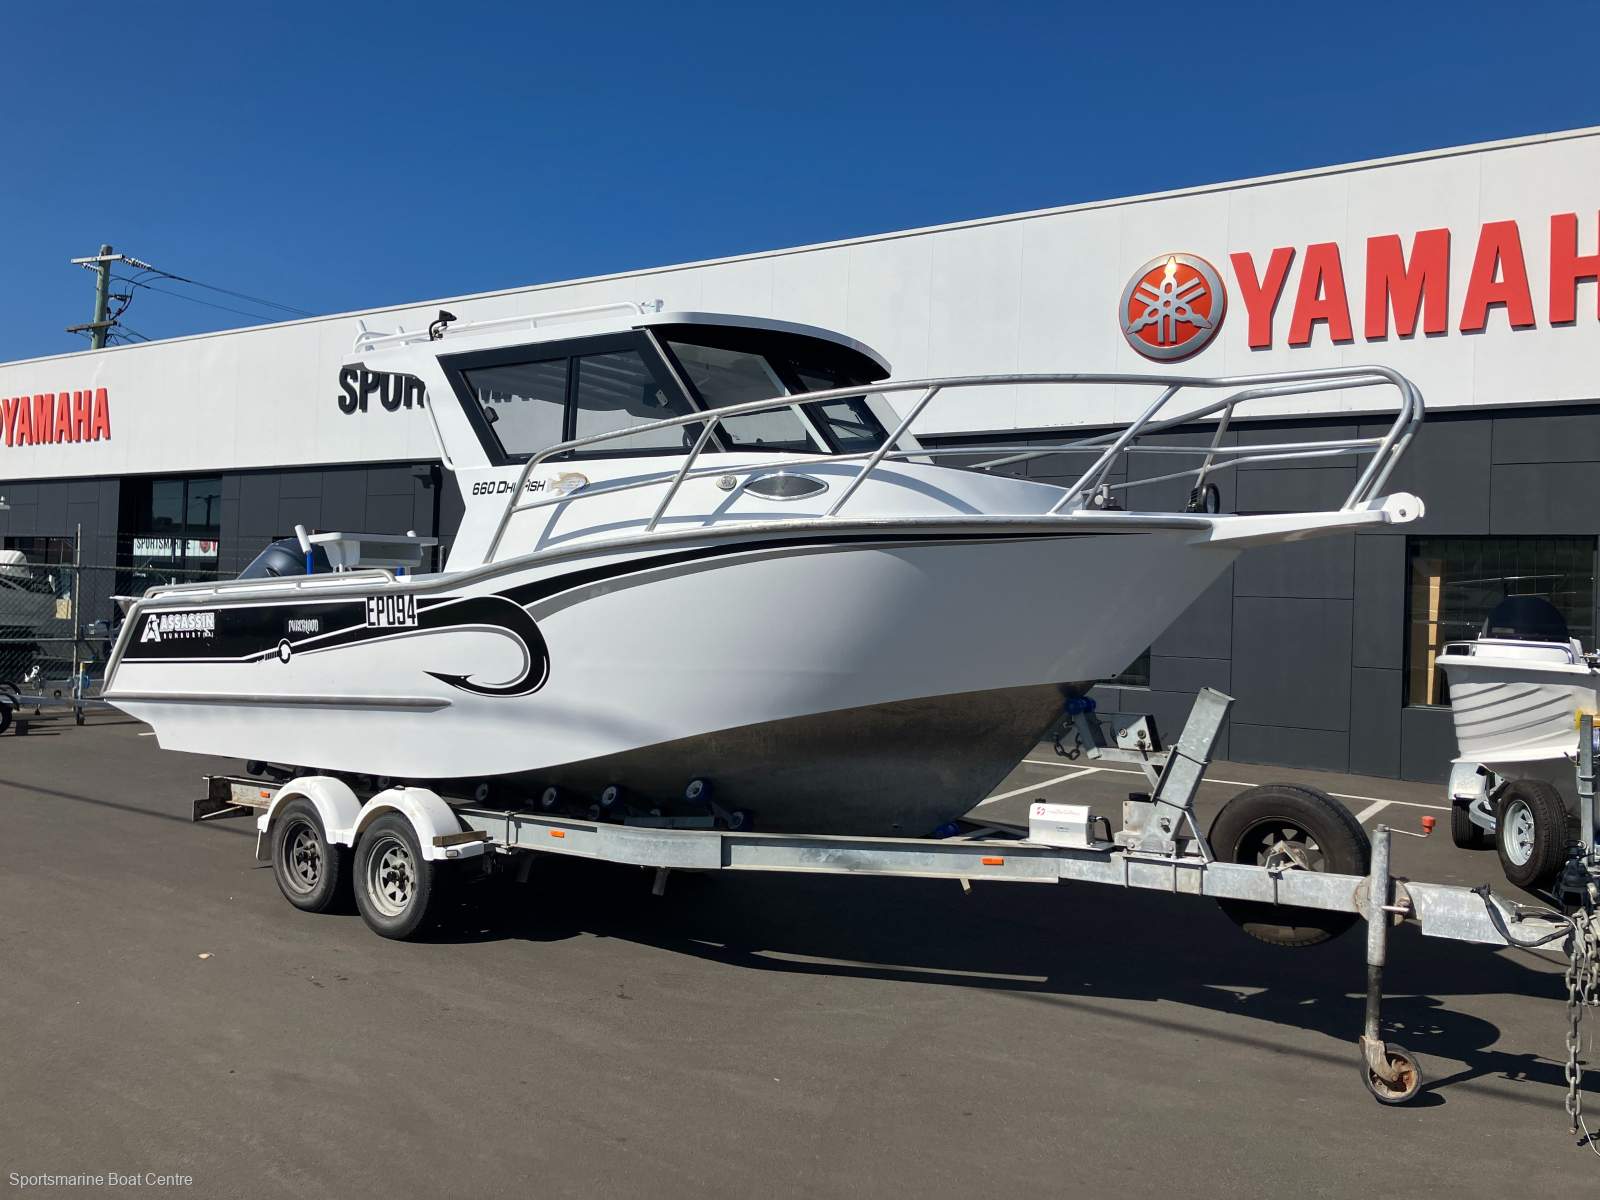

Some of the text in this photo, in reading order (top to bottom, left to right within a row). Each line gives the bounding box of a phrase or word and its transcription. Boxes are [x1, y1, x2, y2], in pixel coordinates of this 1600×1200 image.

[2, 388, 111, 447] YAMAHA
[472, 481, 496, 495] 660
[160, 612, 215, 632] ASSASSIN
